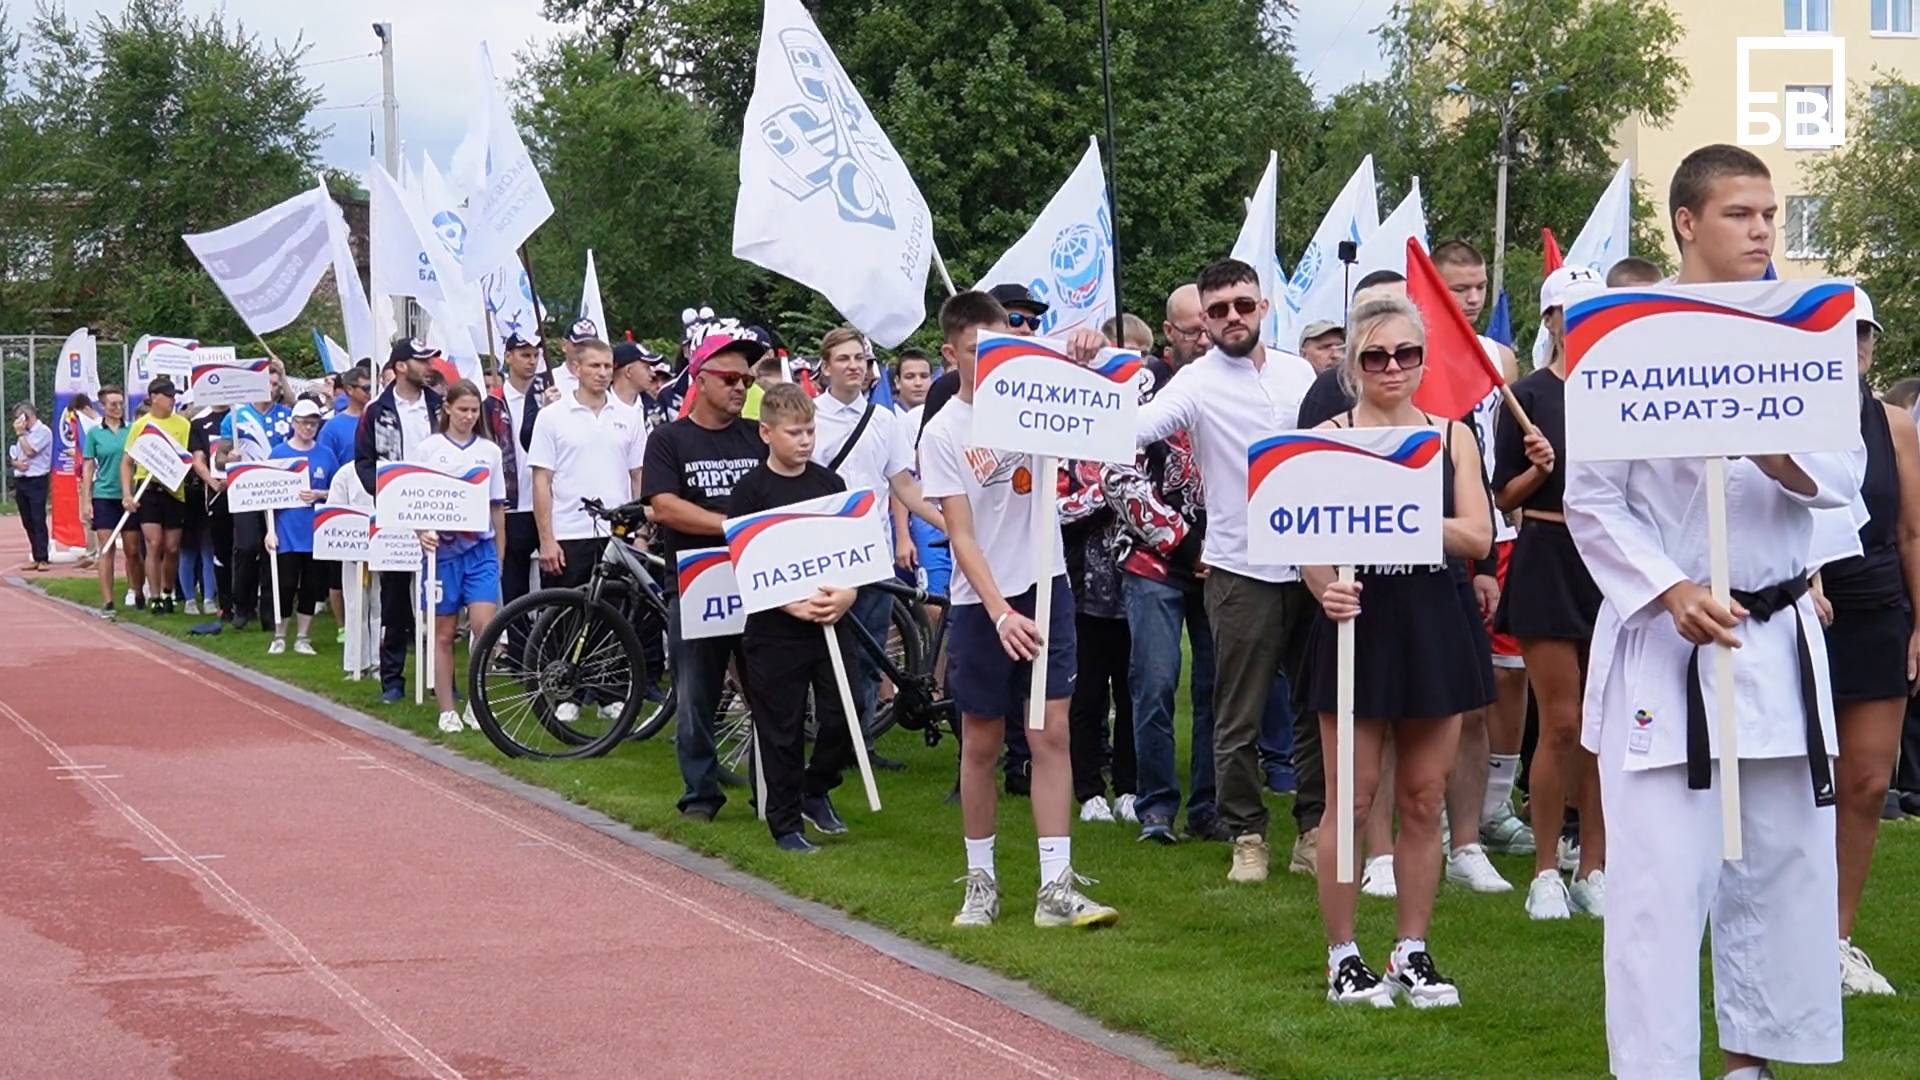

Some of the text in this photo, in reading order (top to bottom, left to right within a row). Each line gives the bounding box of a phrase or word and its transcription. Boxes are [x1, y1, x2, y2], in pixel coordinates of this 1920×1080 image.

[1581, 361, 1844, 390] ТРАДИЦИОННОЕ
[994, 378, 1121, 410] ФИДЖИТАЛ
[1620, 396, 1805, 422] КАРАТЭ-ДО
[1018, 410, 1095, 435] СПОРТ
[251, 488, 289, 497] ФИЛИАЛ
[400, 488, 467, 499] АНО СРПФС
[398, 512, 468, 522] БАЛАКОВО»
[408, 500, 460, 511] «ДРОЗД-
[1269, 504, 1420, 535] ФИТНЕС
[327, 541, 369, 550] КАРАТЭ
[752, 543, 876, 591] ЛАЗЕРТАГ
